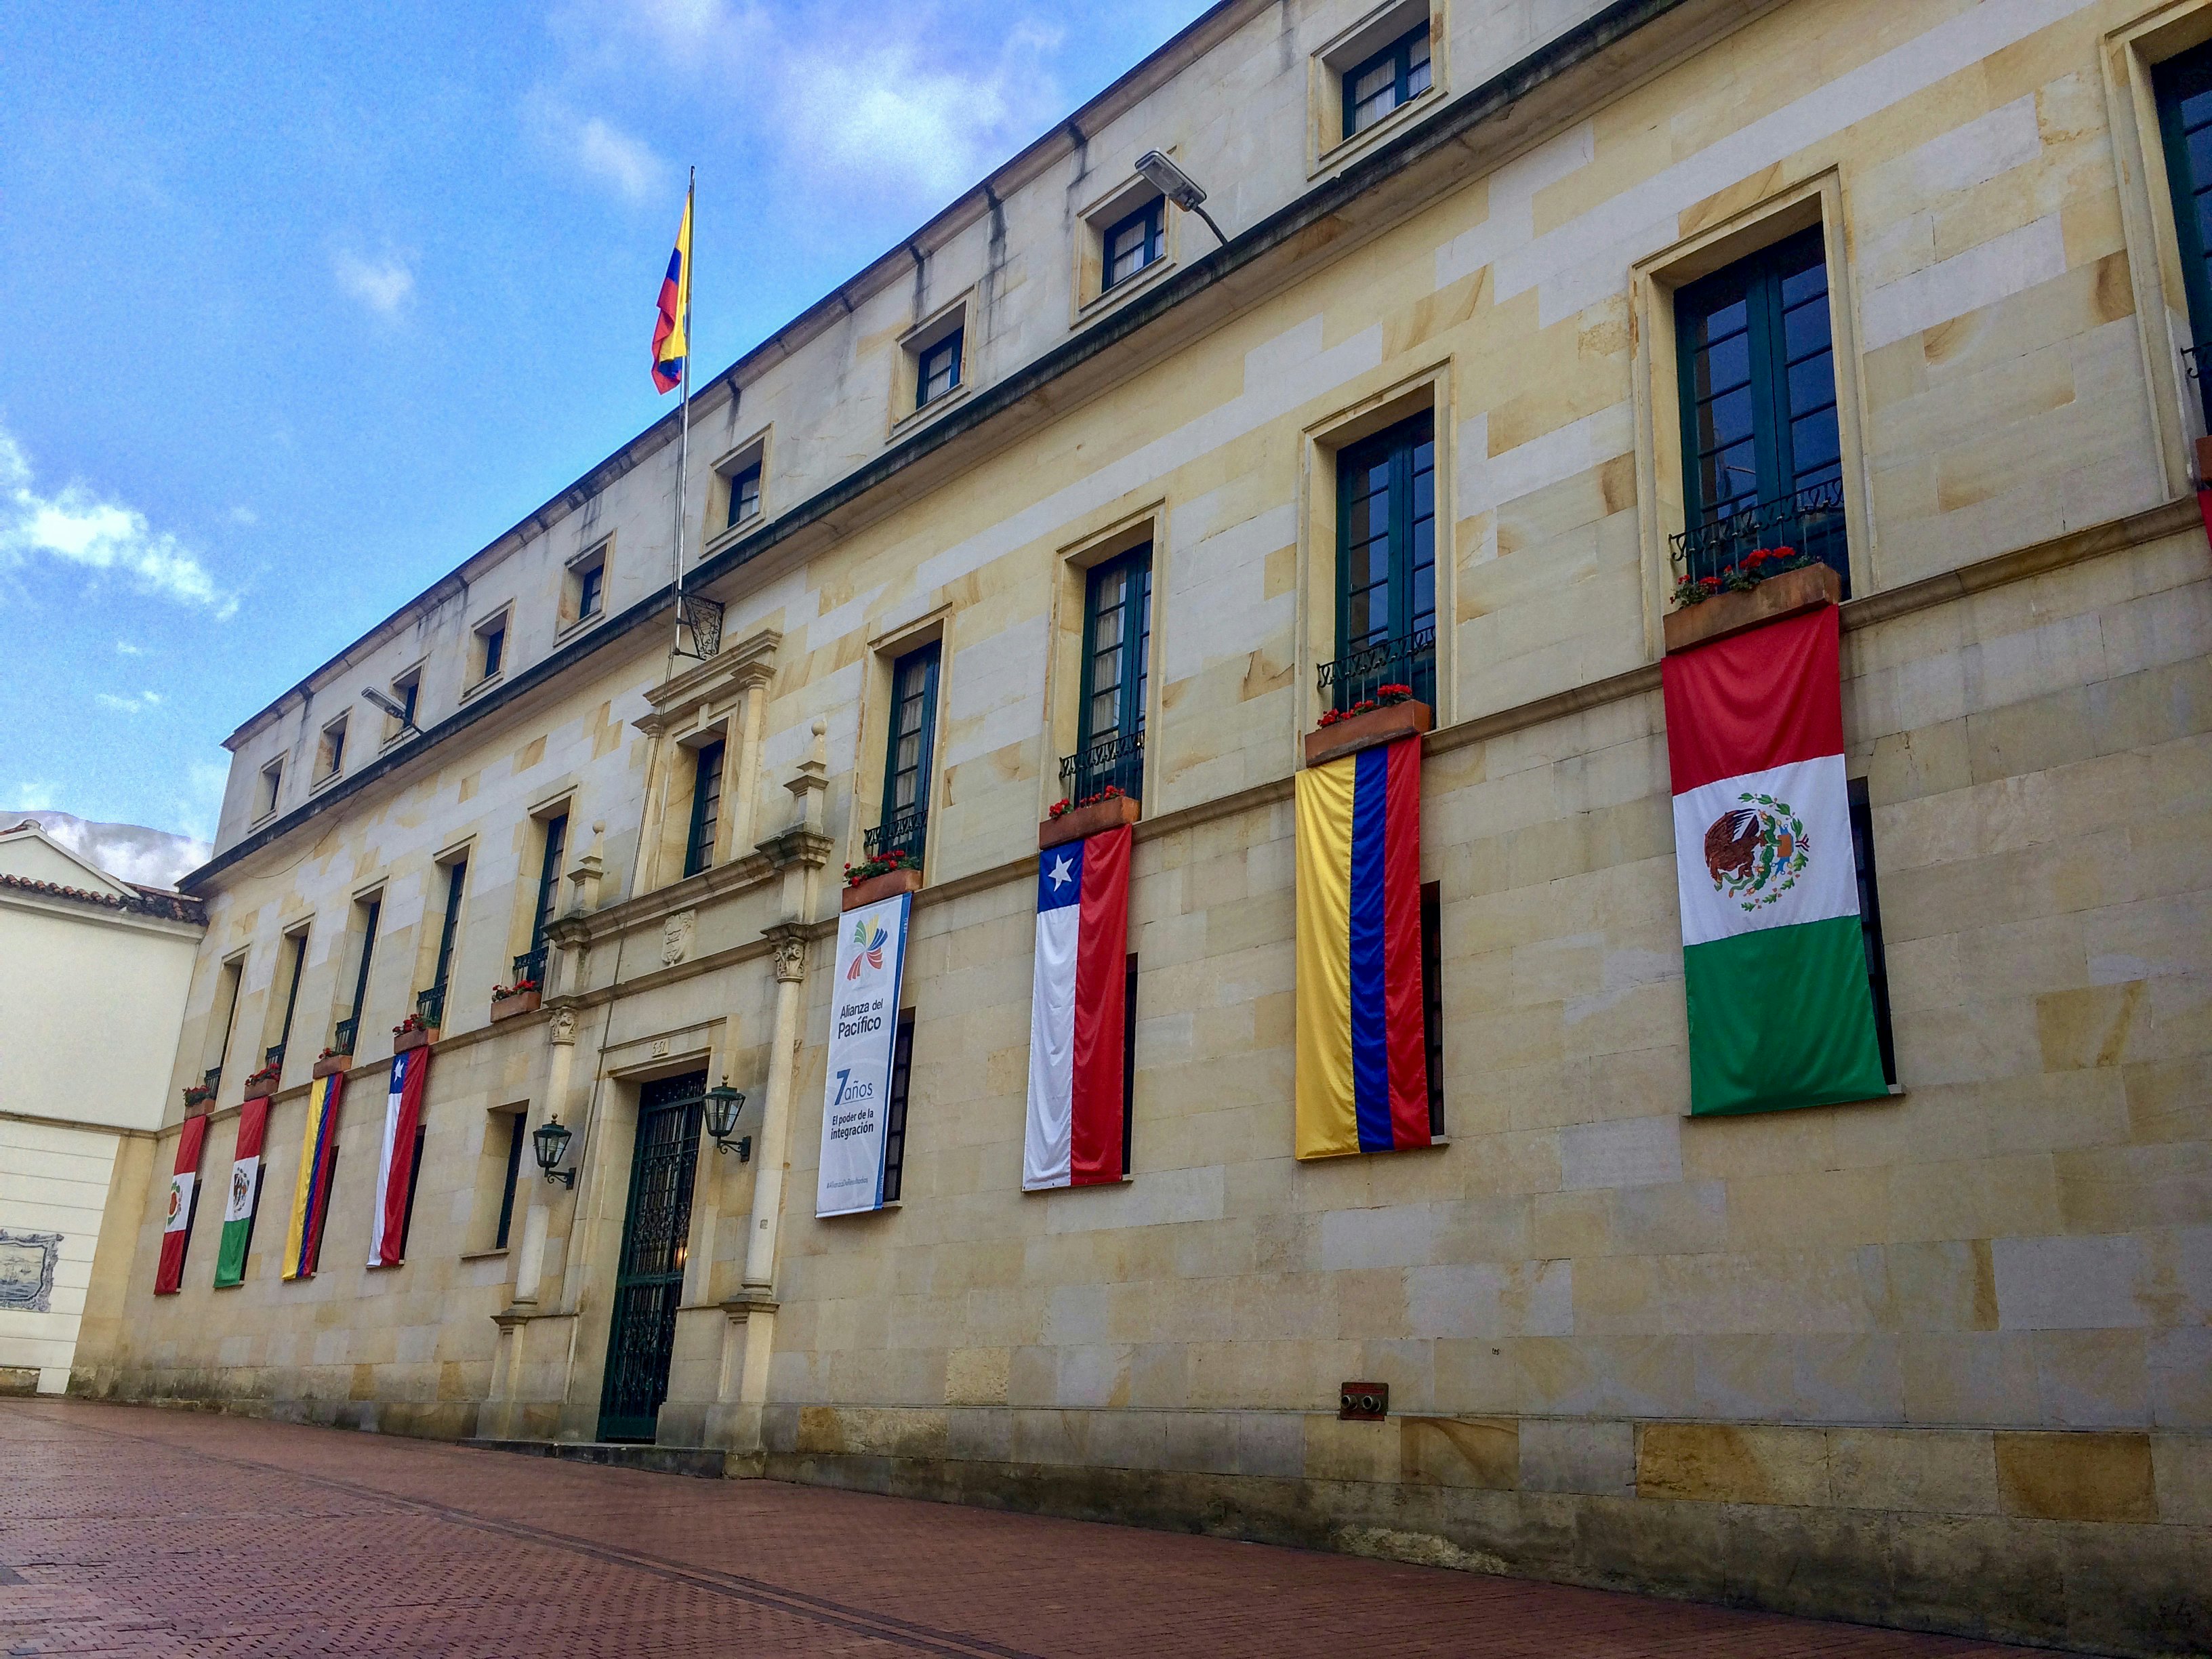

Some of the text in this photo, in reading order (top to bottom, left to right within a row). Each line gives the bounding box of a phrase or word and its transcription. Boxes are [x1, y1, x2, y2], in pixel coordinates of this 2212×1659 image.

[840, 998, 883, 1019] Alianza del
[838, 1016, 882, 1040] Pacífico
[844, 1080, 873, 1101] años
[832, 1108, 874, 1126] El poder de la
[831, 1120, 874, 1140] integración
